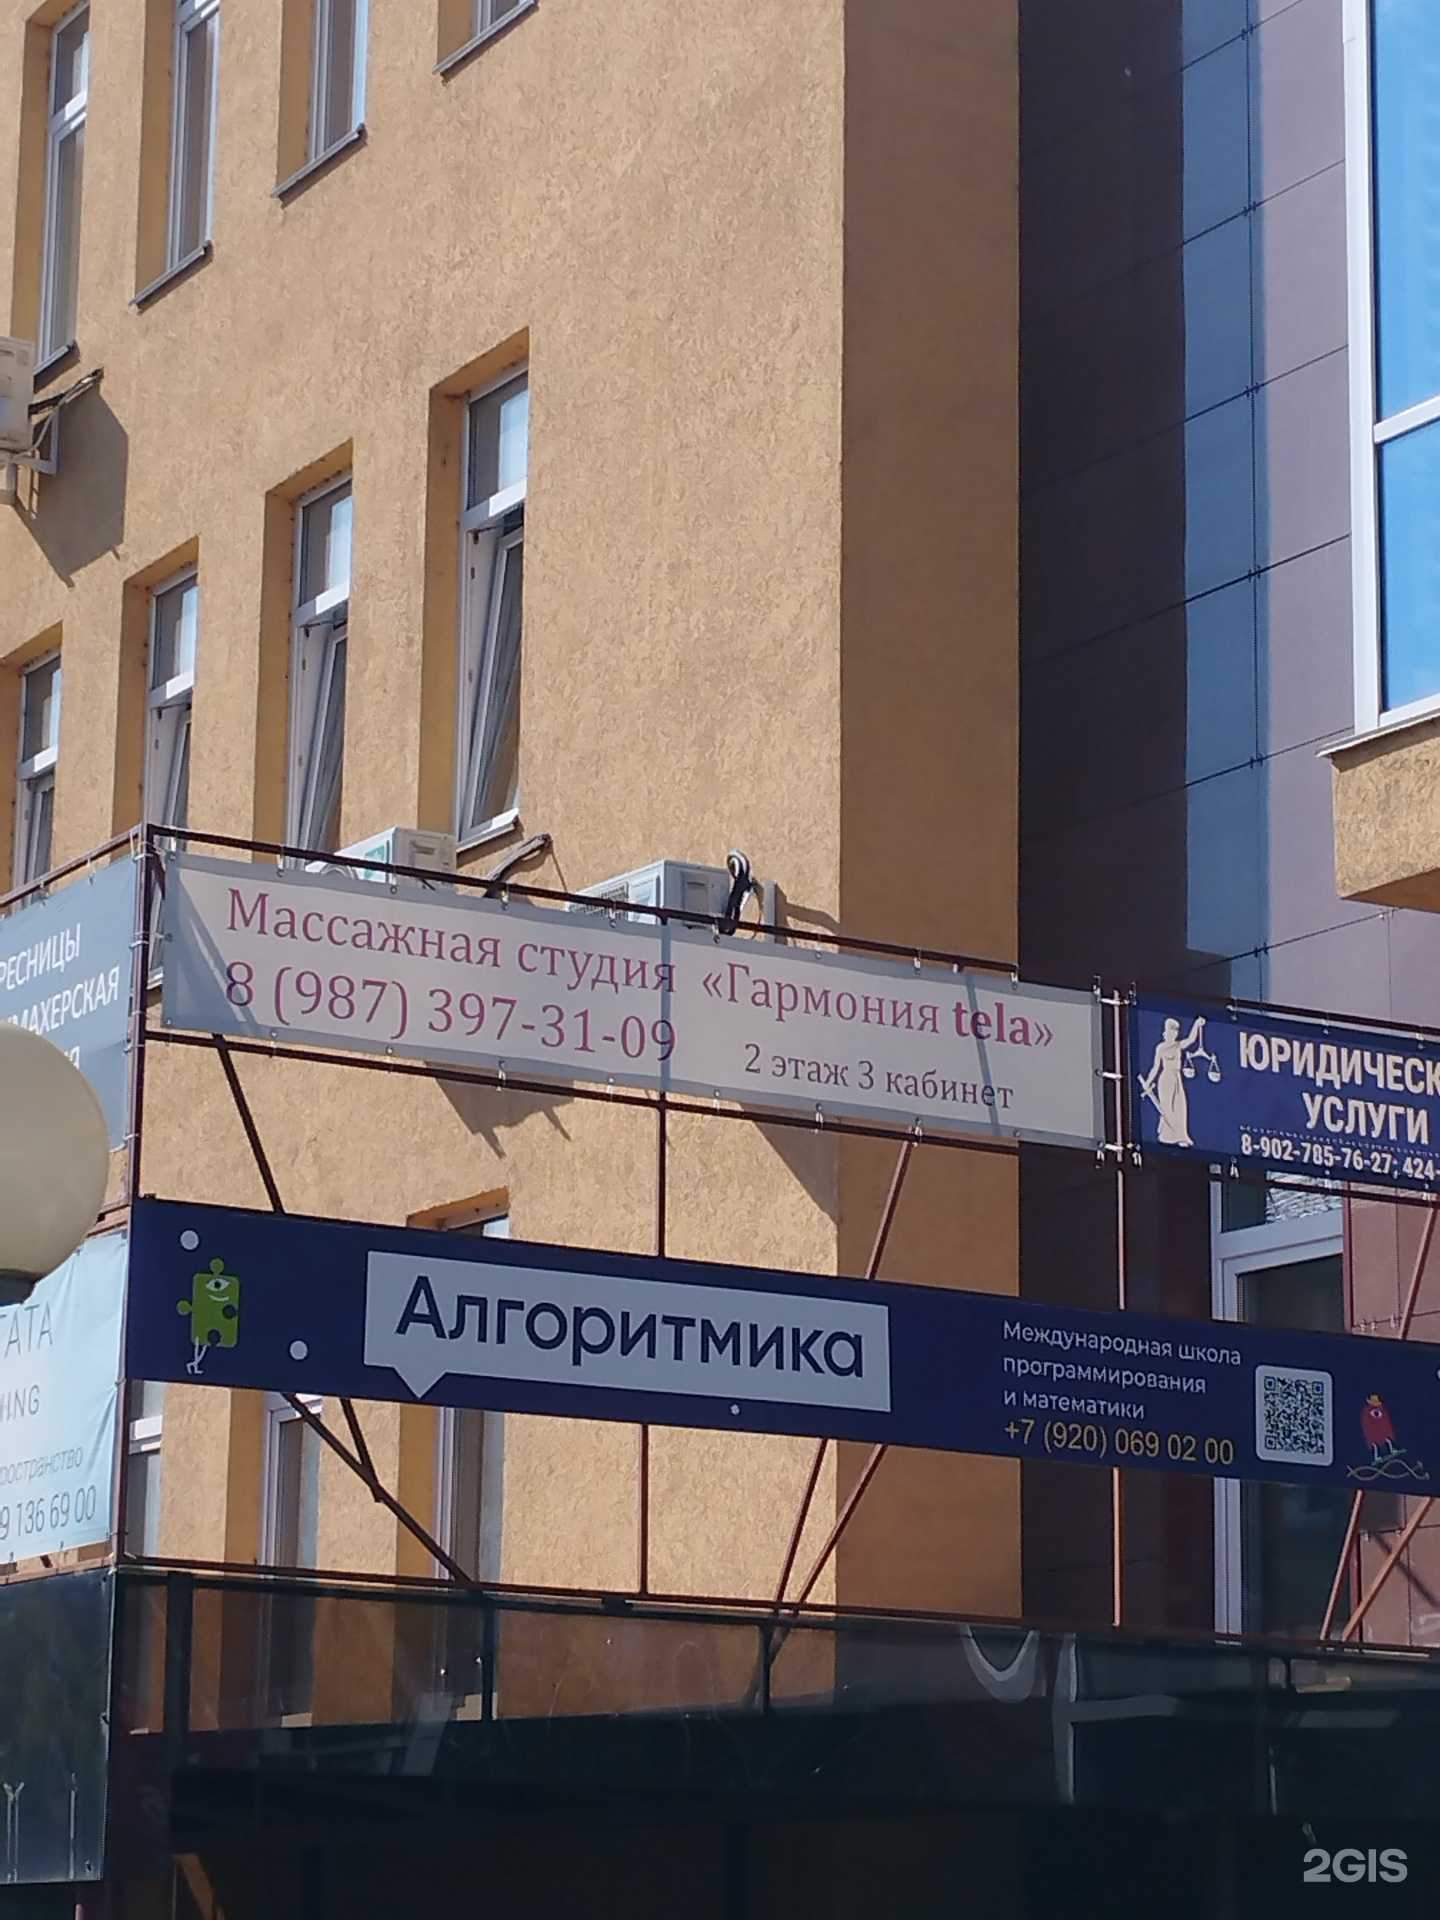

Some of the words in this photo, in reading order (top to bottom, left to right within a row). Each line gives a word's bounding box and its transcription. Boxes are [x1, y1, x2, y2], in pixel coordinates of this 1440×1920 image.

[226, 887, 501, 969] Массажная
[517, 941, 677, 993] студия
[702, 961, 941, 1034] «Гармония
[954, 1000, 1054, 1048] tela»
[225, 961, 255, 1007] 8
[274, 966, 409, 1040] (987)
[428, 987, 677, 1062] 397-31-09
[744, 1043, 762, 1074] 2
[771, 1052, 849, 1088] этаж
[857, 1060, 875, 1091] 3
[885, 1068, 1014, 1109] кабинет
[1239, 1031, 1440, 1097] ЮРИДИЧЕСК
[1302, 1092, 1429, 1145] УСЛУГИ
[395, 1275, 864, 1379] Алгоритмика
[1002, 1320, 1173, 1358] Международная
[1178, 1344, 1242, 1366] школа
[1003, 1357, 1207, 1394] программирования
[1003, 1389, 1017, 1406] и
[1023, 1393, 1145, 1420] математики
[1004, 1418, 1035, 1445] +7
[1043, 1421, 1108, 1458] (920)
[1114, 1430, 1160, 1457] 069
[1167, 1436, 1197, 1462] 02
[1204, 1439, 1235, 1465] 00
[17, 1498, 45, 1536] 136
[50, 1492, 70, 1529] 69
[75, 1484, 97, 1523] 00
